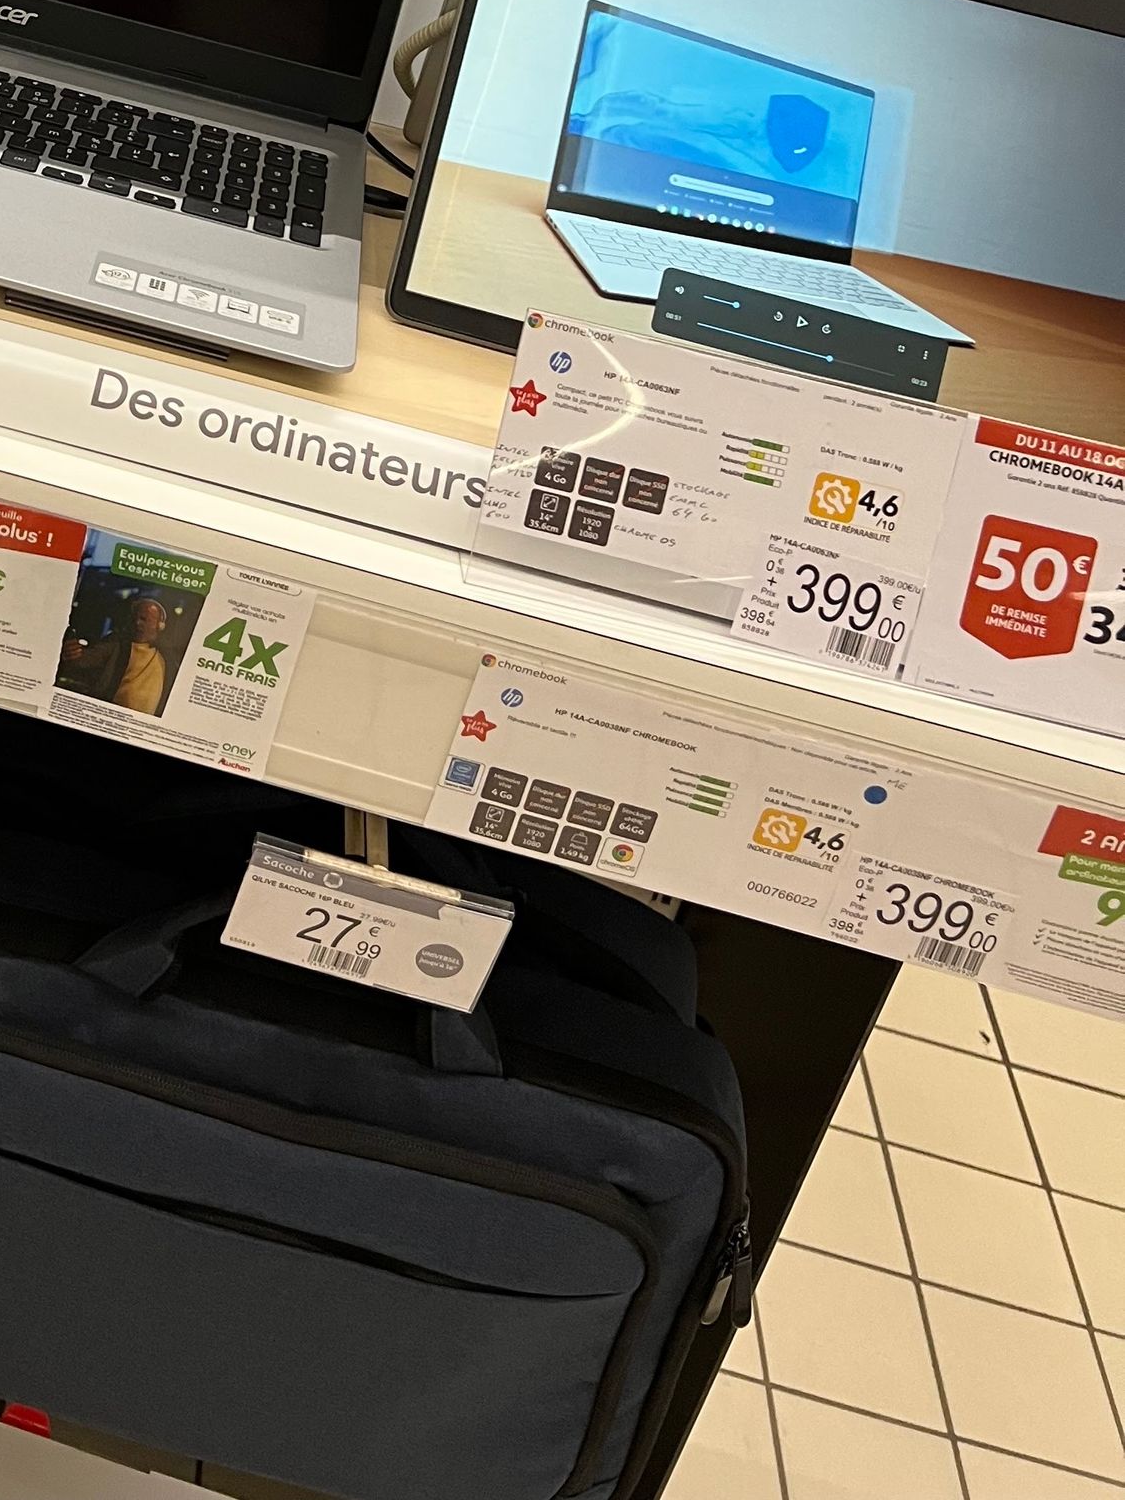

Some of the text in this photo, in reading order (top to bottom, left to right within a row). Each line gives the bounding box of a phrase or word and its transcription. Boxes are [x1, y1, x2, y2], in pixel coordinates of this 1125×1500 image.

[552, 353, 570, 371] hp
[90, 367, 185, 429] Des
[198, 406, 488, 510] ordinateurs
[1015, 432, 1100, 464] DU 11 AU 18
[989, 449, 1124, 492] CHROMEBOOK 14A
[1007, 473, 1036, 486] Garantie
[858, 489, 900, 518] 4,6
[804, 516, 829, 529] INDICE
[118, 561, 207, 590] L'esprit léger
[119, 548, 206, 577] Equipez-vous
[975, 535, 1091, 603] 50€
[239, 572, 261, 584] TOUTE
[787, 563, 906, 643] 399 00
[991, 603, 1048, 626] DE REMISE
[985, 616, 1048, 638] IMMÉDIATE
[196, 657, 277, 689] SANS FRAIS
[497, 658, 568, 686] chromebook
[554, 707, 698, 753] HP CHROMEBOOK
[222, 742, 257, 759] oney
[218, 757, 251, 773] Auchan
[746, 842, 772, 856] INDICE
[803, 826, 846, 851] 4,6
[263, 854, 315, 880] Sacoche
[1069, 856, 1098, 868] Pour
[278, 882, 355, 910] SACOCHE BLEU
[746, 880, 818, 909] 000766022
[933, 875, 995, 900] CHROMEBOOK
[875, 883, 997, 953] 399 00
[295, 906, 382, 960] 27 99
